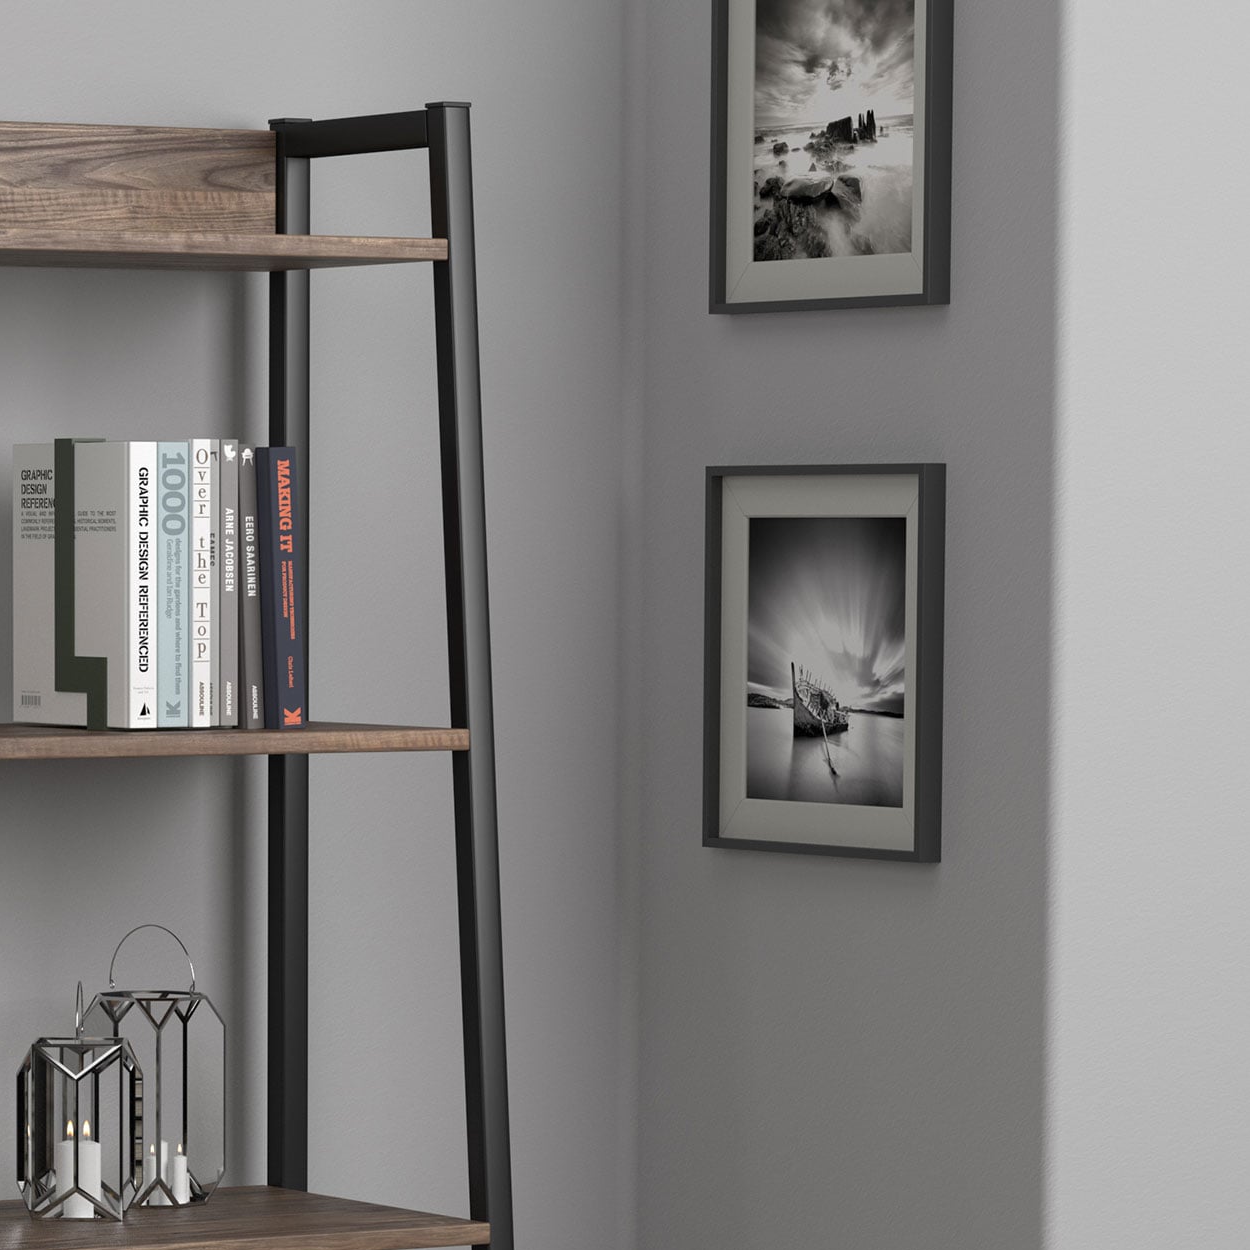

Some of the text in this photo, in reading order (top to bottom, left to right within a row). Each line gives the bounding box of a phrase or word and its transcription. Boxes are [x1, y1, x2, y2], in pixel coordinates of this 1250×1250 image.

[21, 469, 53, 480] GRAPHIC
[21, 483, 47, 494] DESIGN
[138, 467, 149, 527] GRAPHIC
[161, 452, 186, 536] 1000
[277, 459, 293, 553] MAKING IT
[138, 531, 149, 580] DESIGN
[166, 571, 174, 584] and
[173, 538, 182, 565] designs
[196, 448, 209, 659] Over the Top
[225, 507, 234, 592] ARNE JACOBSEN
[245, 516, 257, 597] EERO SAARINEN
[138, 585, 149, 673] REFERENCED
[173, 589, 182, 617] gardens
